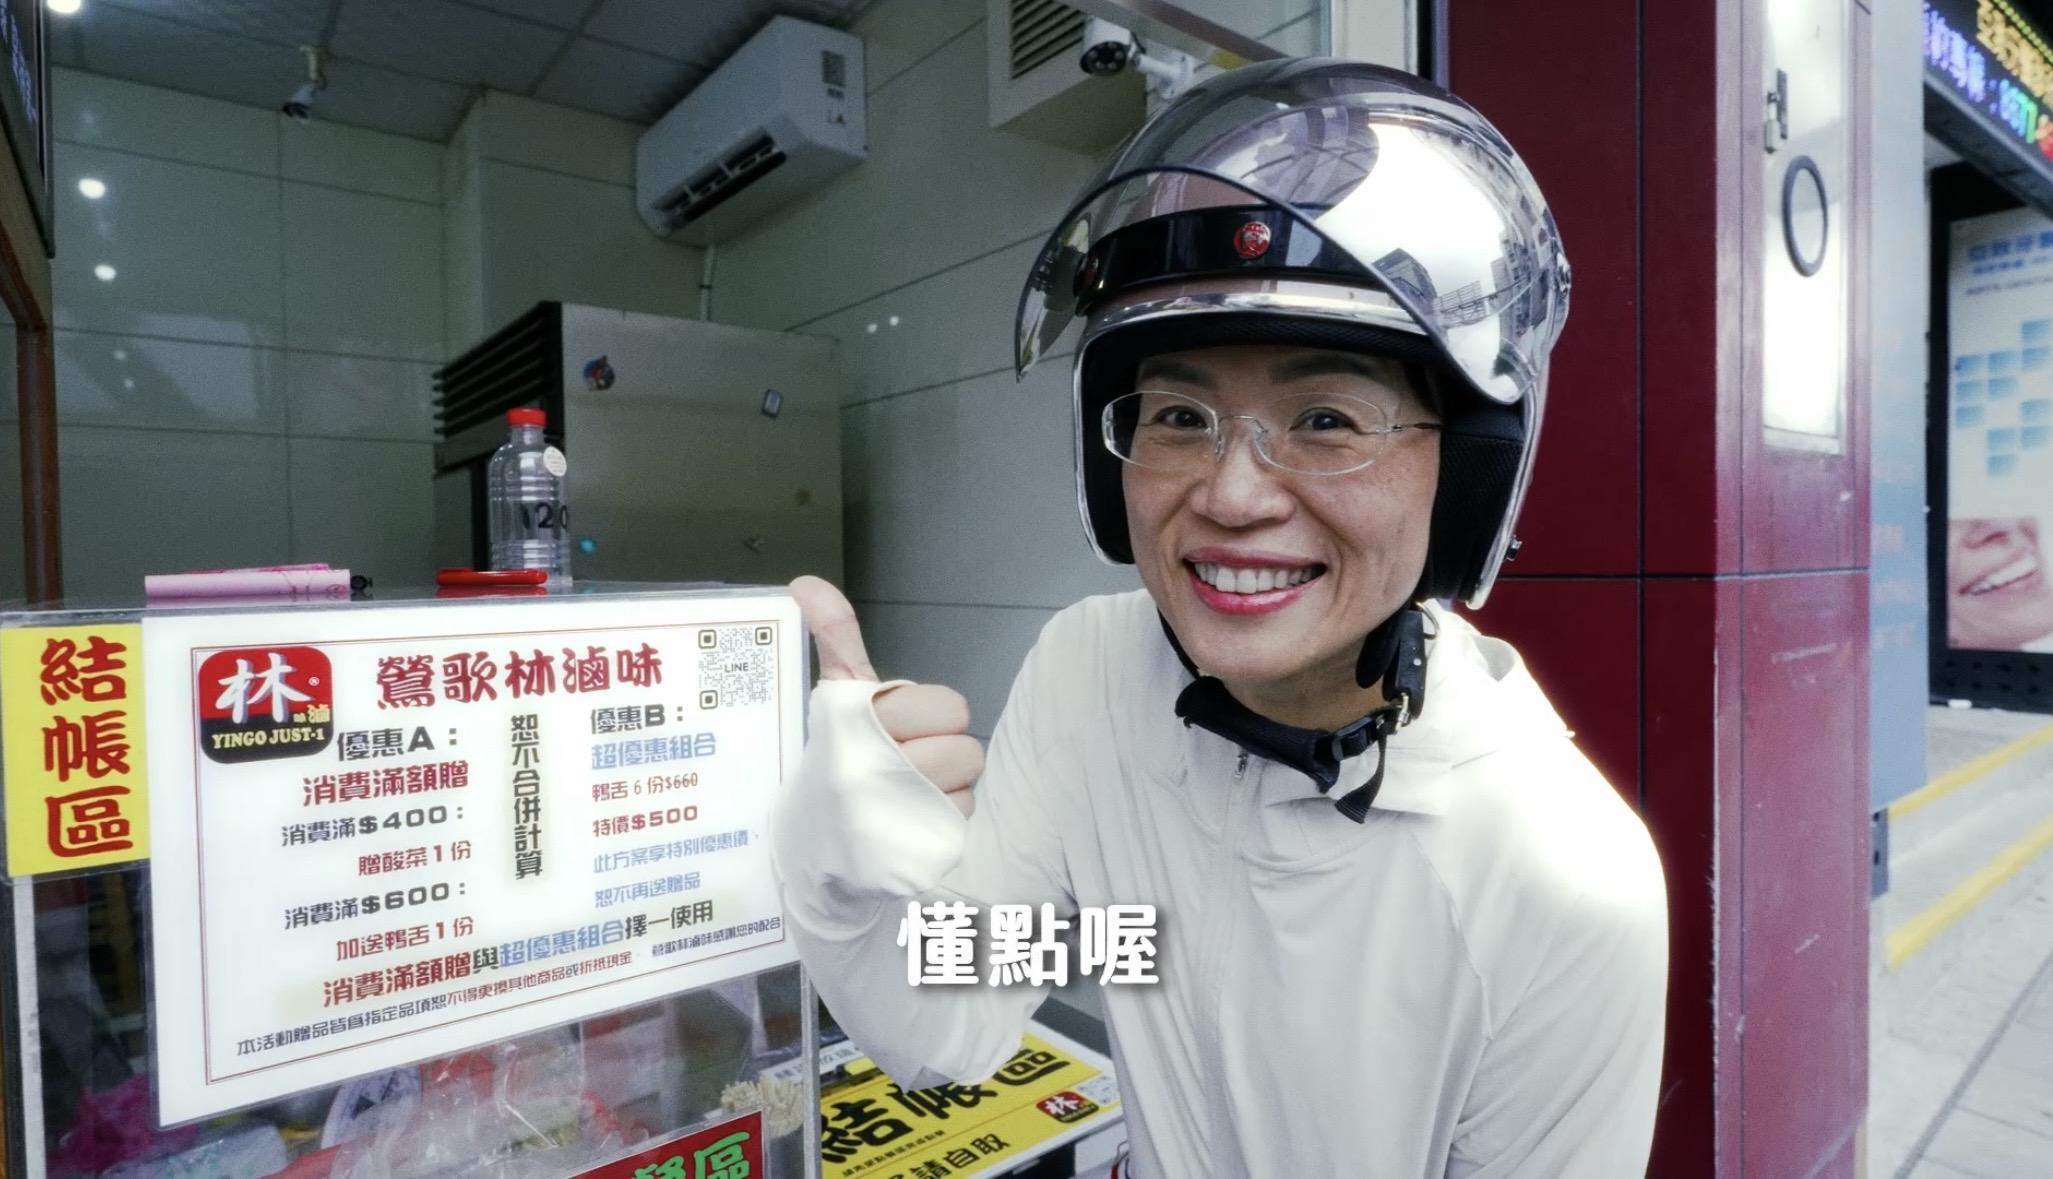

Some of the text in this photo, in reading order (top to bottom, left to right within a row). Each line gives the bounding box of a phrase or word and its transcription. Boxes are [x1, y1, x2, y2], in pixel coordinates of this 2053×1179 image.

[215, 652, 315, 724] 林
[376, 642, 662, 709] 鶯歌林滷味
[724, 662, 749, 673] LINE
[39, 636, 133, 858] 結帳區
[212, 727, 325, 749] YINGO JUST-1
[591, 732, 716, 770] 超優惠組合
[303, 760, 469, 807] 消費滿額贈
[510, 714, 542, 880] 恕不合併計算
[592, 805, 698, 837] 特價$500
[595, 871, 701, 908] 恕不再送贈品
